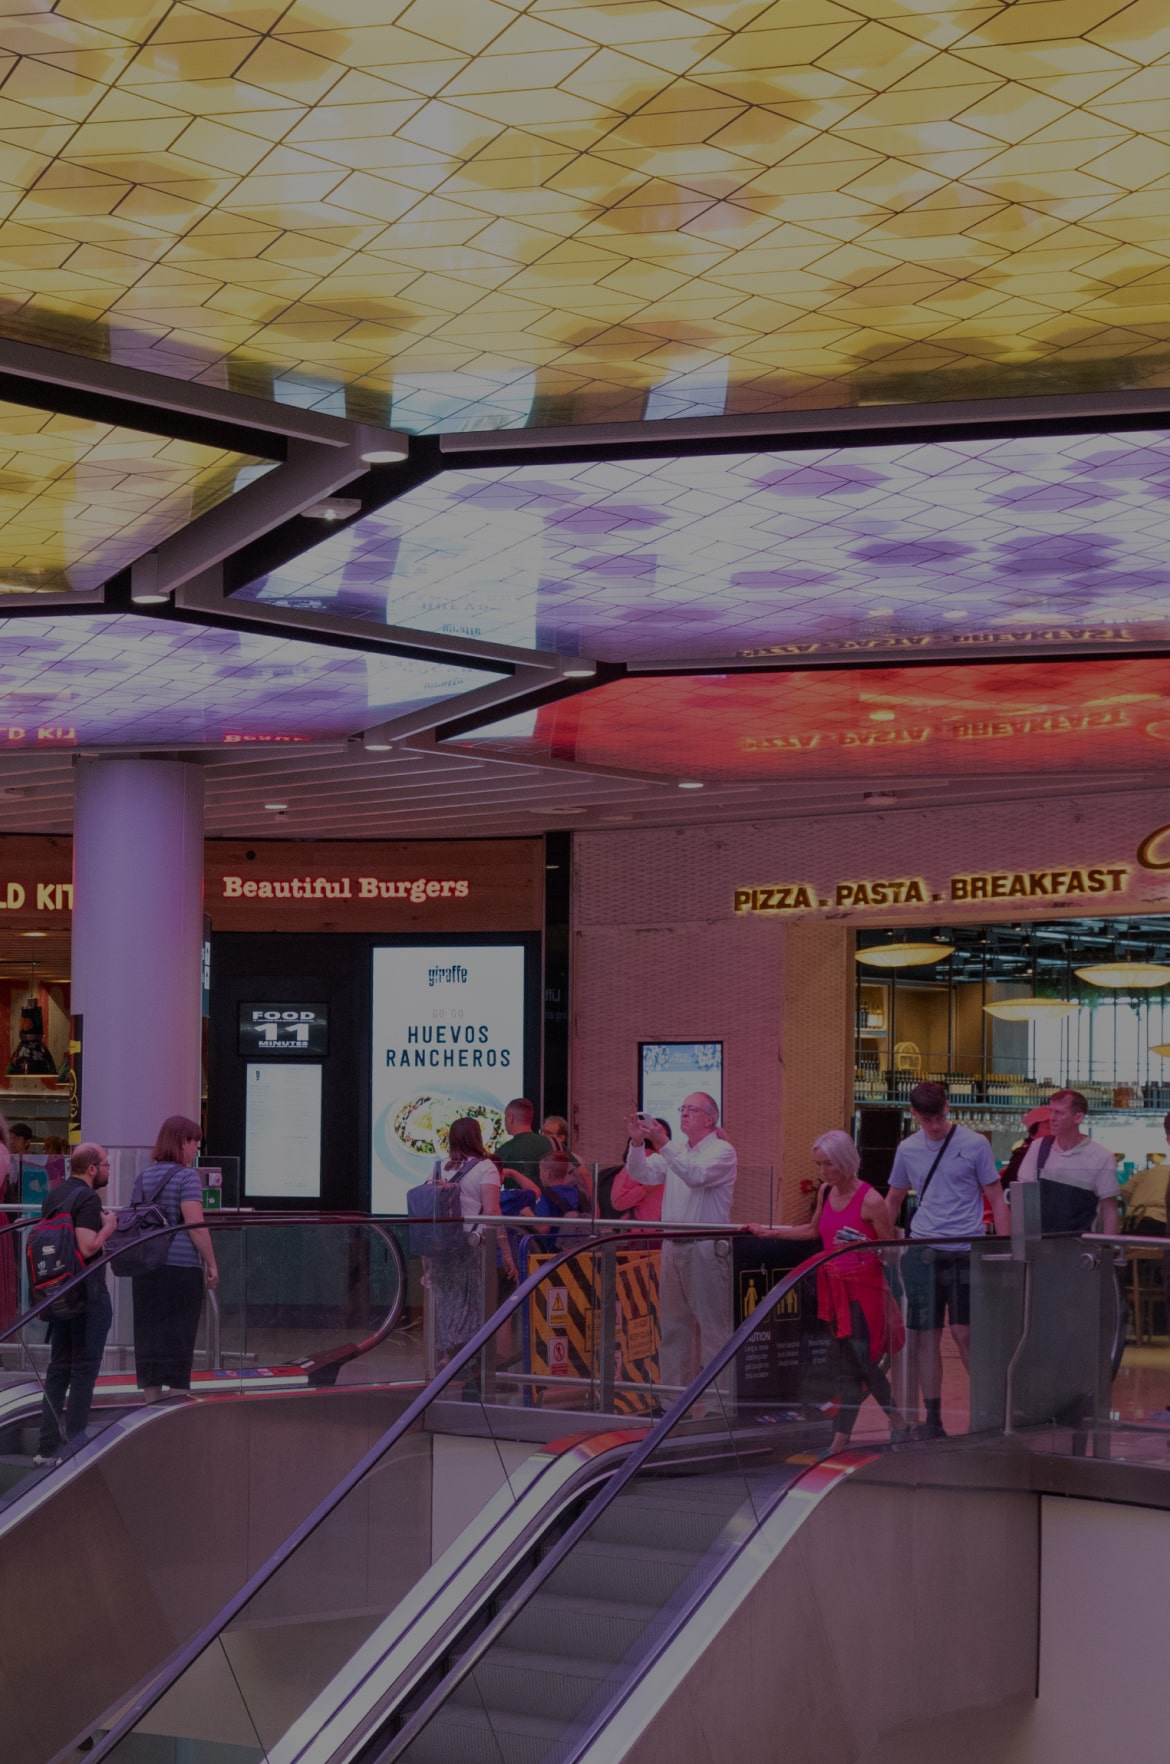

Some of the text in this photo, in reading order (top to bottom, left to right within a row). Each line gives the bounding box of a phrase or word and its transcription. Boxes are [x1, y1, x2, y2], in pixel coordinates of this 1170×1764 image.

[223, 876, 470, 903] Beautiful Burgers
[734, 869, 1128, 911] PIZZA PASTA BREAKFAST
[428, 965, 468, 987] giraffe
[252, 1011, 315, 1020] FOOD
[254, 1023, 309, 1041] 11
[408, 1025, 489, 1044] HUEVOS
[386, 1049, 511, 1068] RANCHEROS
